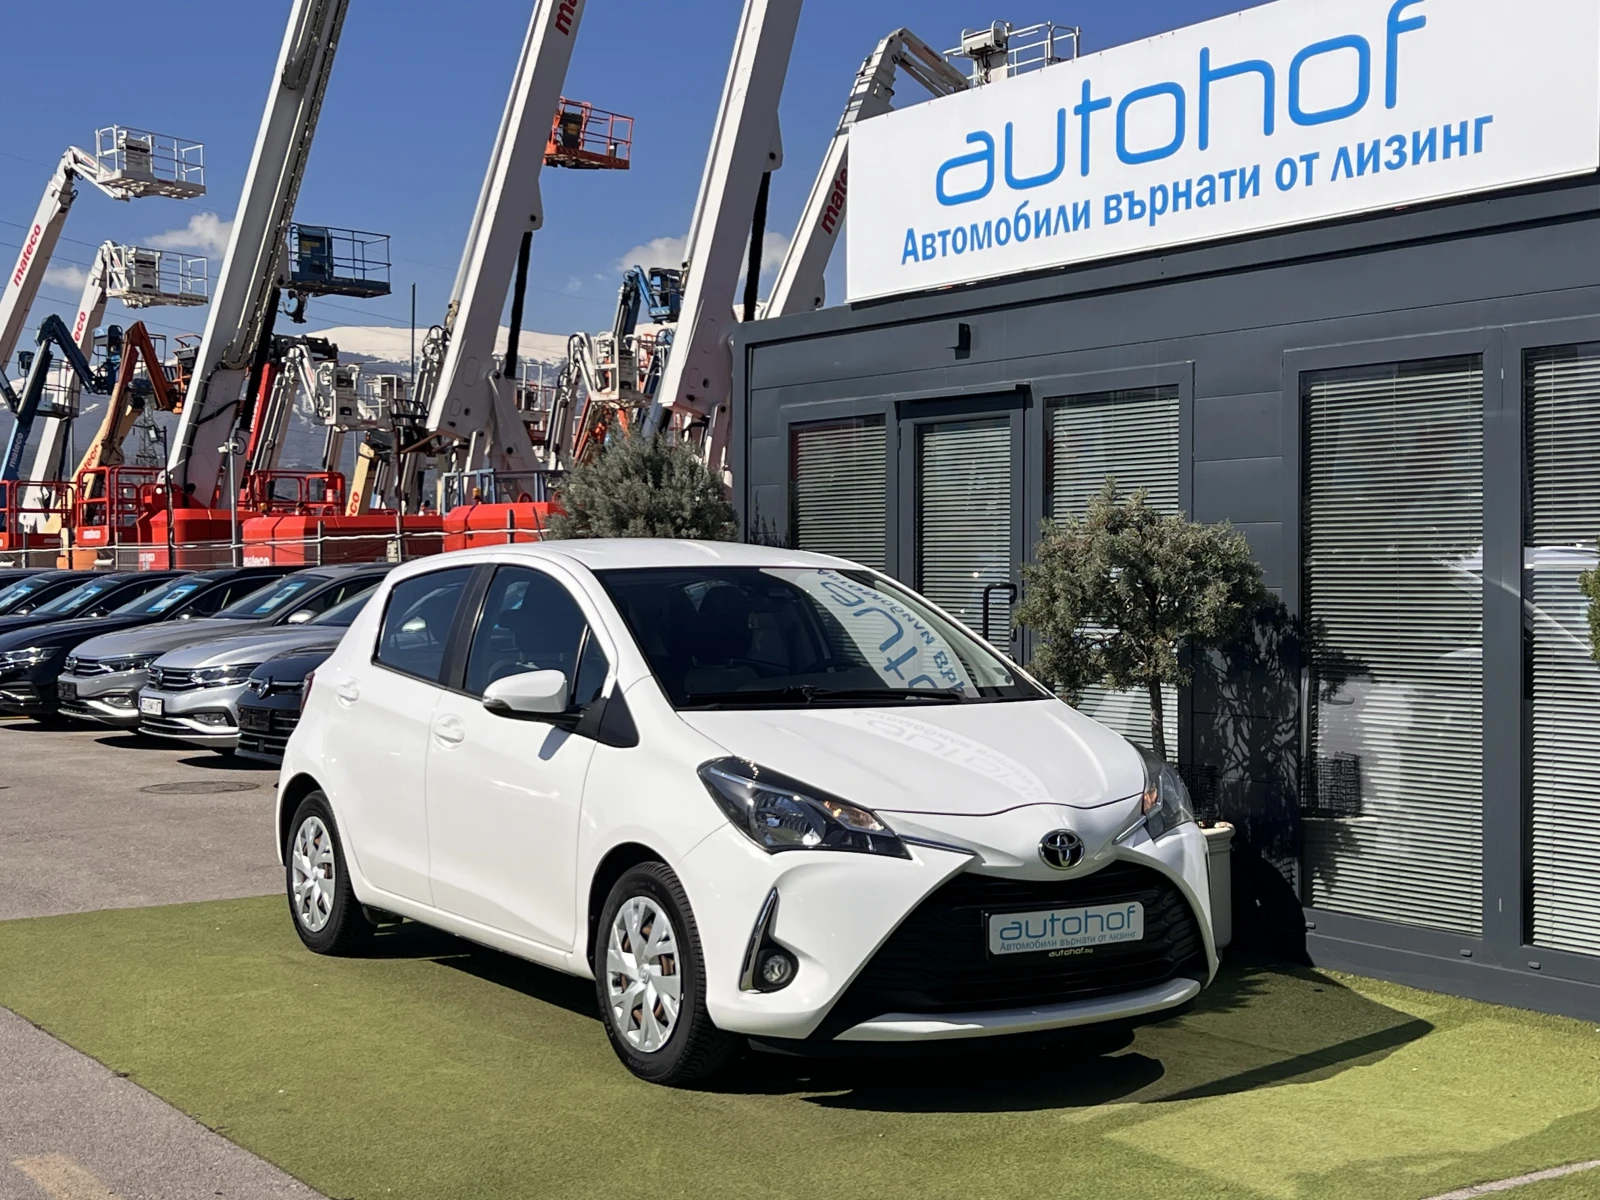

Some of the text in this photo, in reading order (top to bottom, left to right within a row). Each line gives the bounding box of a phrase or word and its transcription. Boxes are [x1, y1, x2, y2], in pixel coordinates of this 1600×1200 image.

[936, 0, 1427, 207] autohof
[821, 156, 848, 235] mate
[901, 114, 1494, 266] Автомобили върнати от лизинг
[13, 224, 41, 287] mateco
[1000, 905, 1136, 940] autohof
[1000, 937, 1058, 952] Автомобили
[1060, 935, 1096, 948] върнати
[1098, 934, 1107, 943] от
